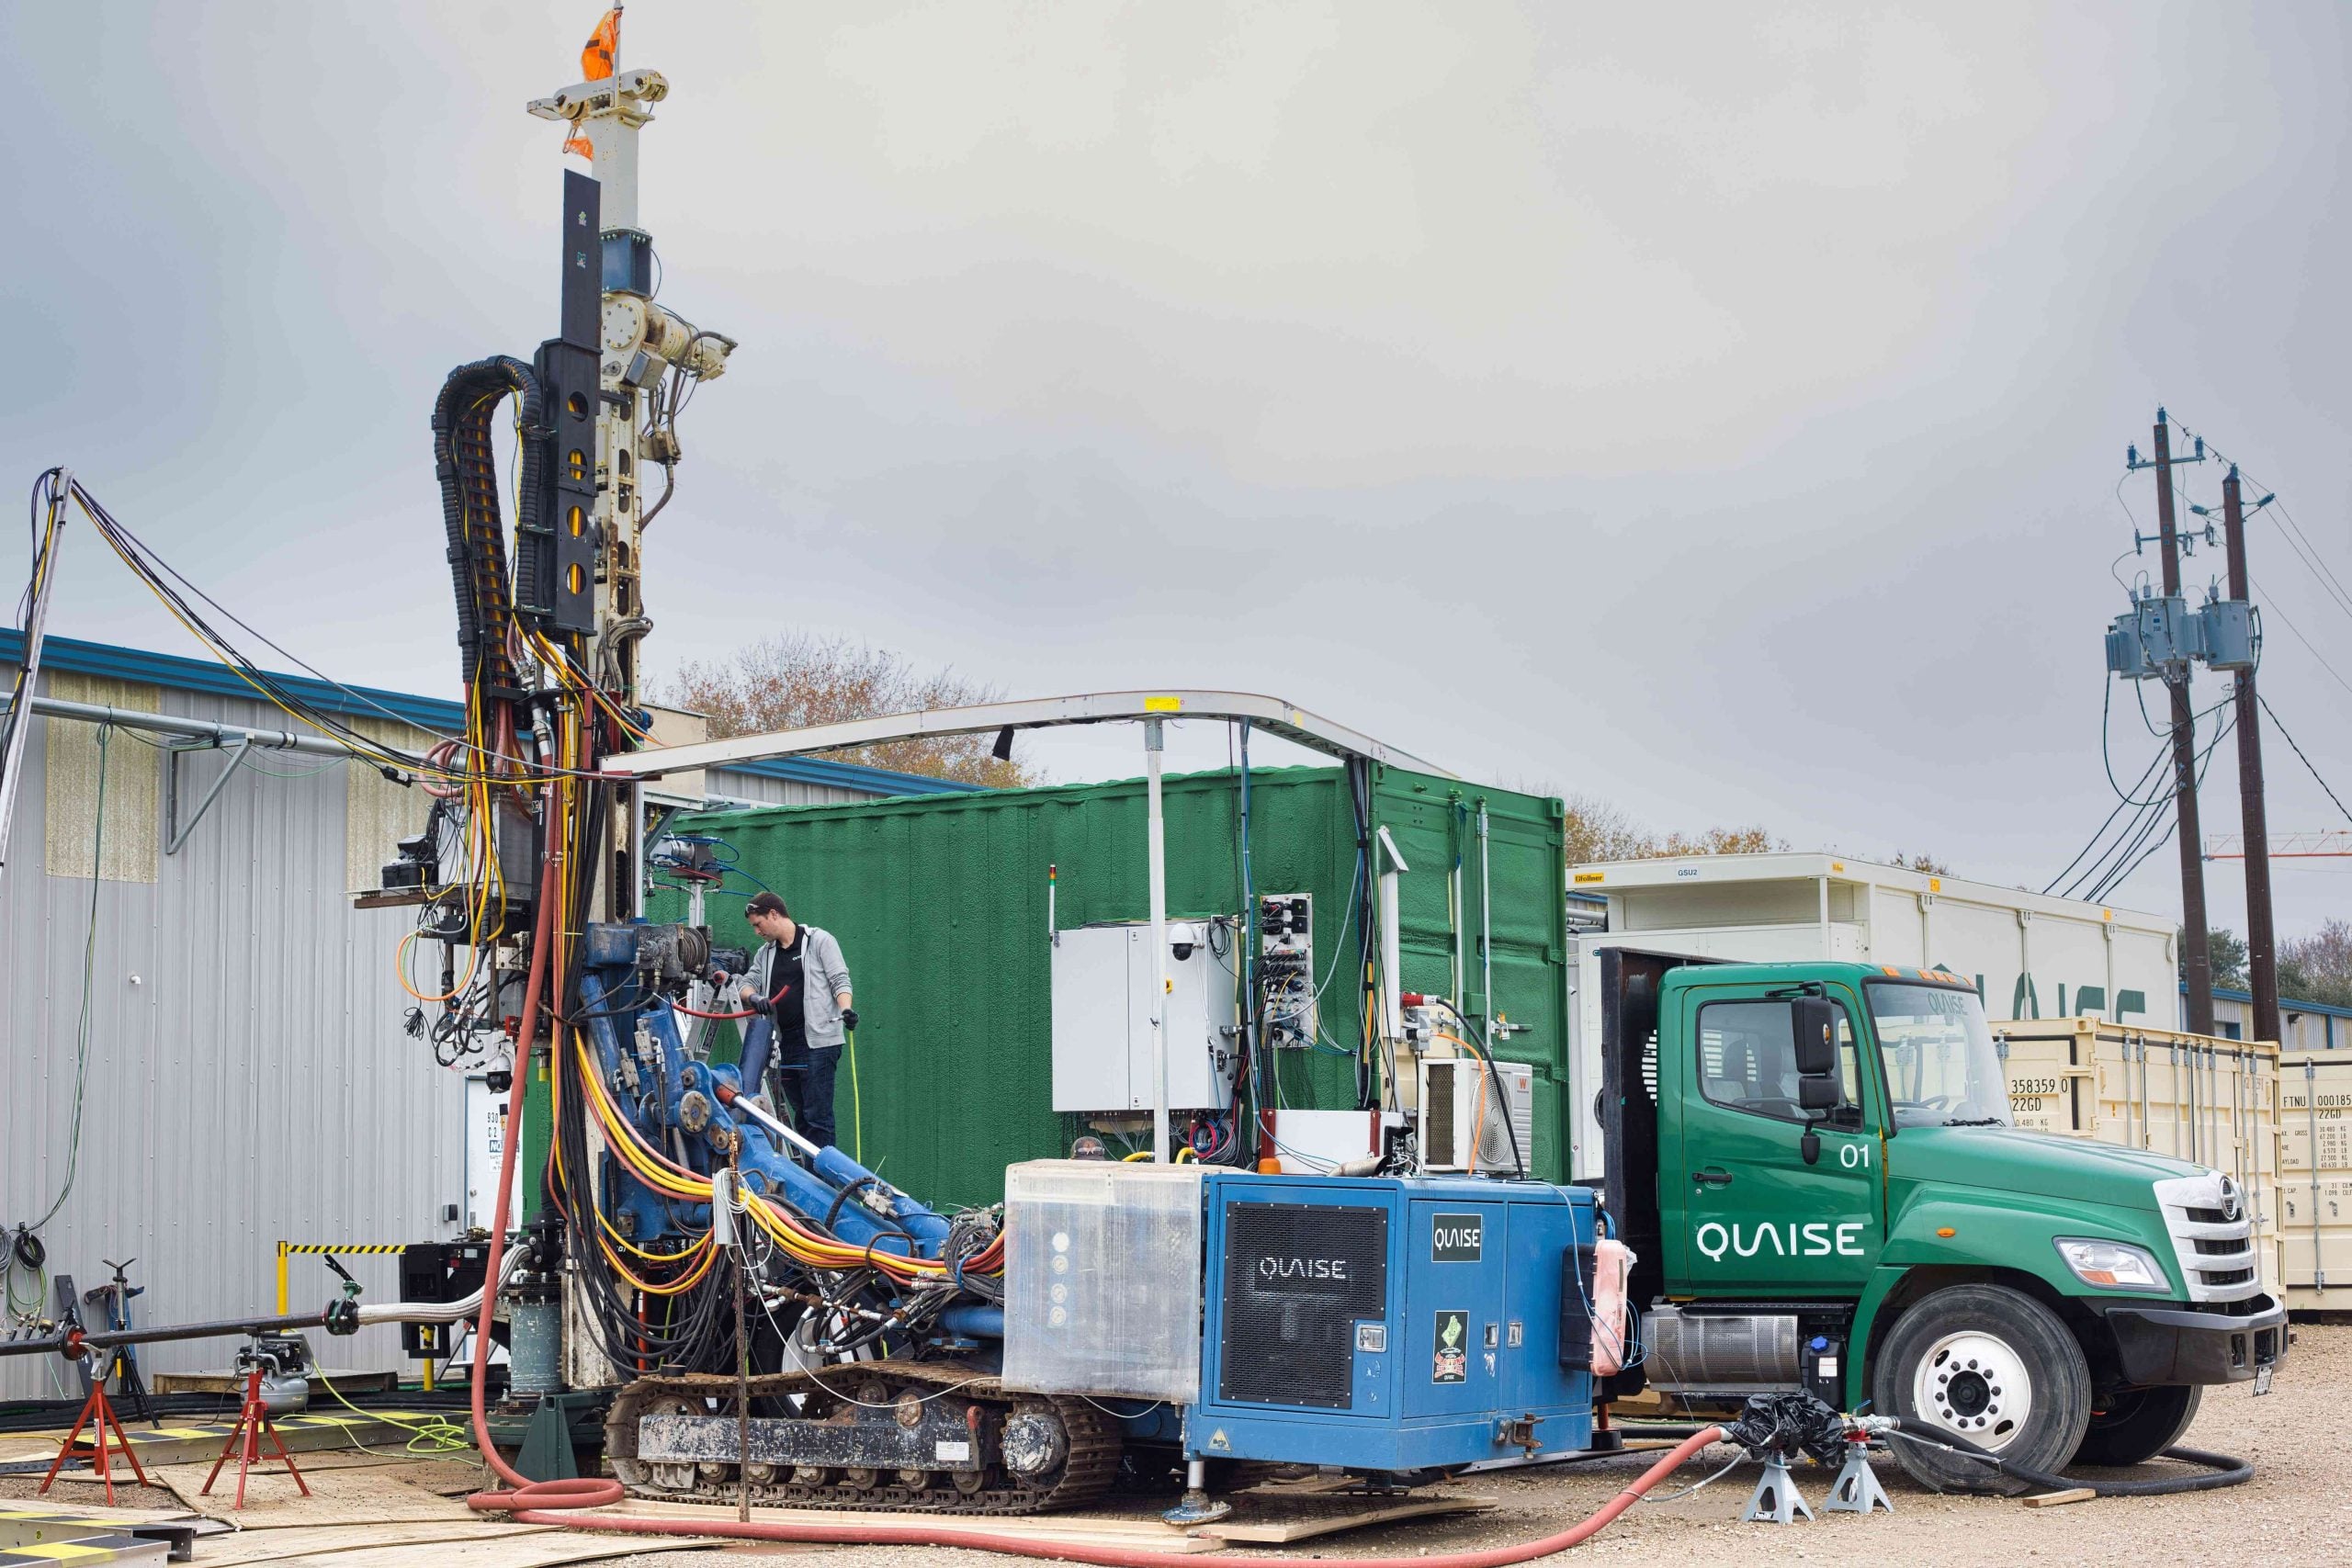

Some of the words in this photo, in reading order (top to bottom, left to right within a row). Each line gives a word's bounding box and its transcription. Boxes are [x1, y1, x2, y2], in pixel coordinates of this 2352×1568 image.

[2011, 1078, 2055, 1094] 358359
[2061, 1078, 2068, 1093] 0
[2012, 1097, 2041, 1111] 22GD
[2283, 1096, 2306, 1107] FTNU
[2317, 1095, 2352, 1106] 000185
[2319, 1109, 2342, 1119] 22GD
[2016, 1119, 2034, 1127] 0.480
[1840, 1144, 1869, 1168] 01
[1434, 1228, 1480, 1251] QUAISE
[1697, 1223, 1864, 1262] QUAISE
[1260, 1257, 1347, 1280] QUAISE
